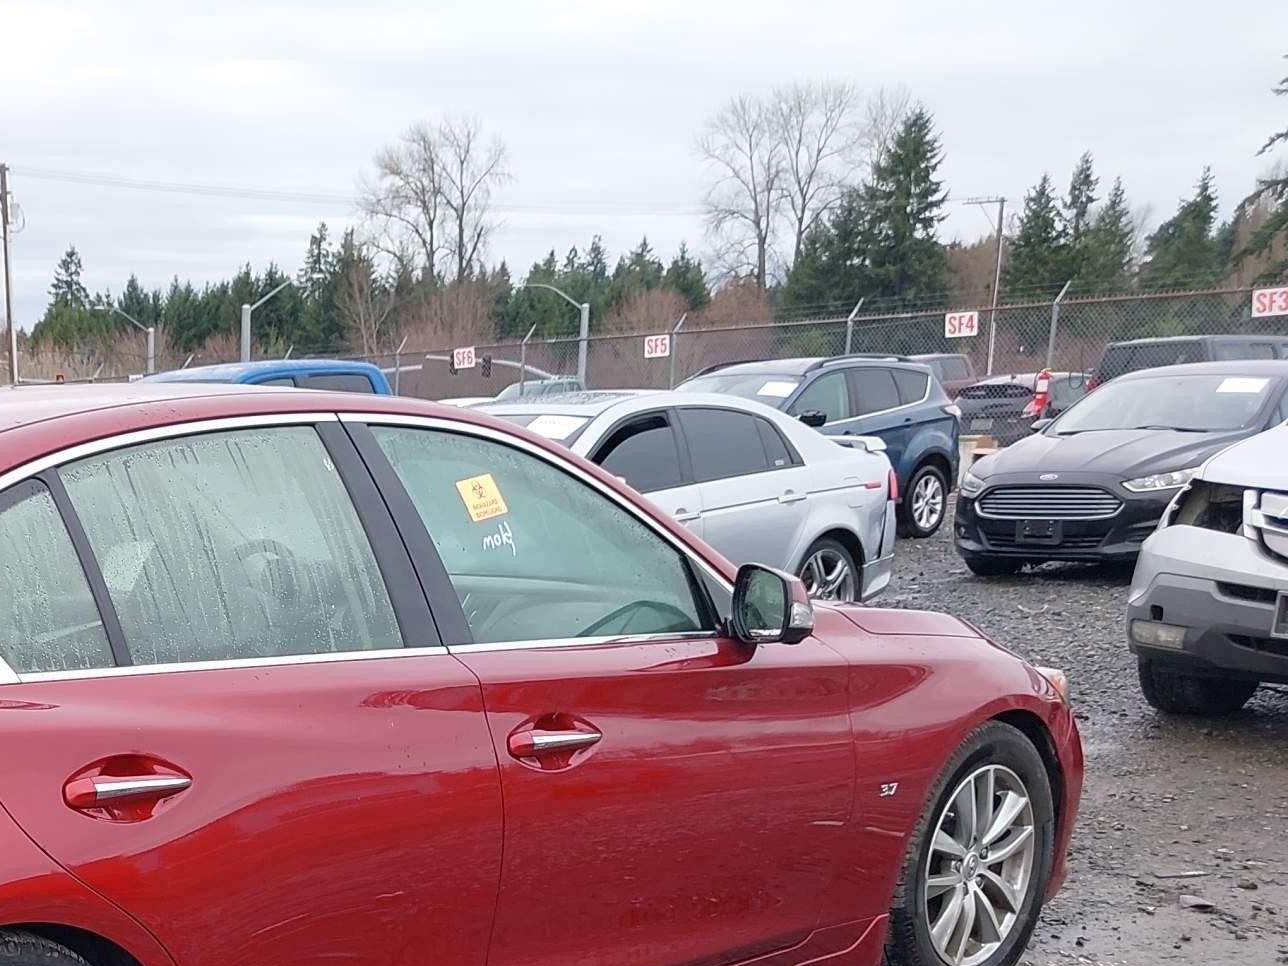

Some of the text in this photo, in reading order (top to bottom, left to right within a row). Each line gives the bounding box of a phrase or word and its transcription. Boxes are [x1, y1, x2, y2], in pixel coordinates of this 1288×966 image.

[1256, 291, 1288, 313] SF3
[948, 315, 975, 335] SF4
[647, 337, 667, 355] SF5
[455, 350, 473, 366] SF6
